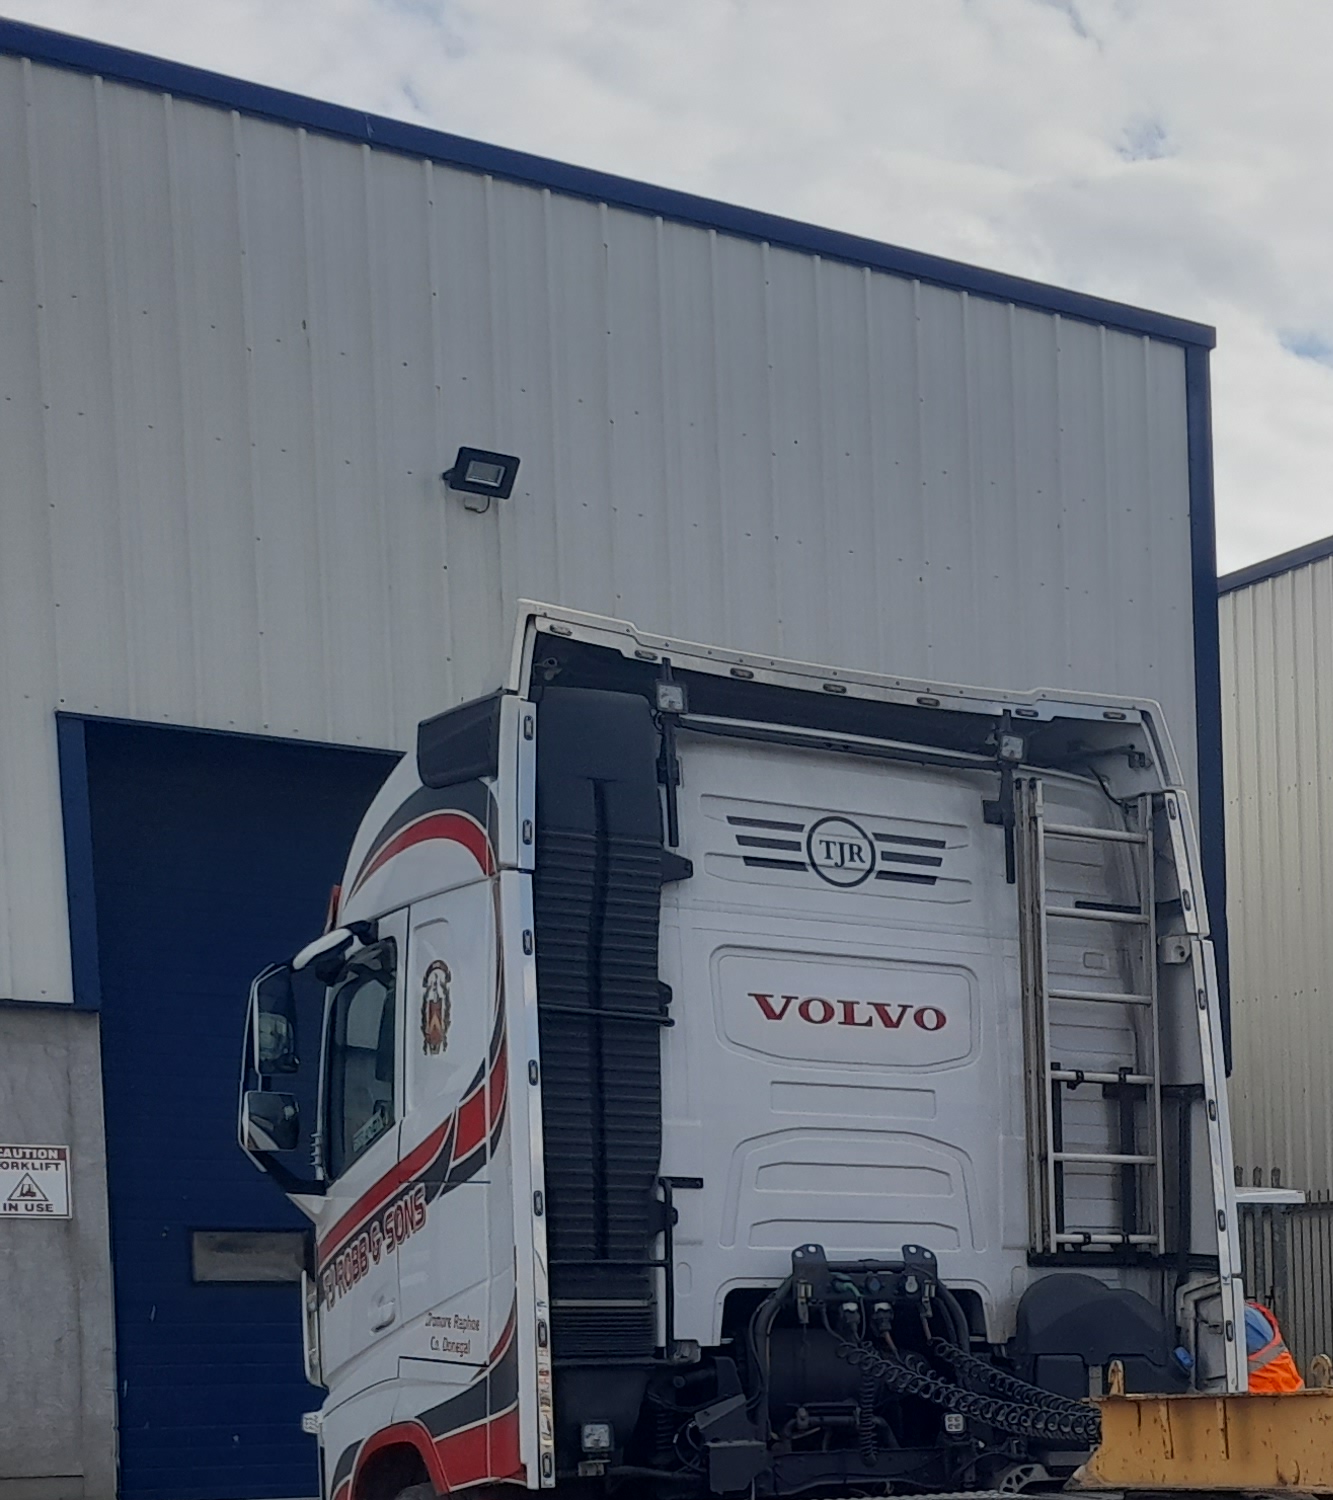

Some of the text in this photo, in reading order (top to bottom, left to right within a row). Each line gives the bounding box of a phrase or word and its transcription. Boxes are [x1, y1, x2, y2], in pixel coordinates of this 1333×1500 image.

[819, 839, 866, 868] TJR
[747, 992, 947, 1031] VOLVO
[0, 1161, 61, 1171] ORKLIFT
[3, 1203, 54, 1213] IN USE
